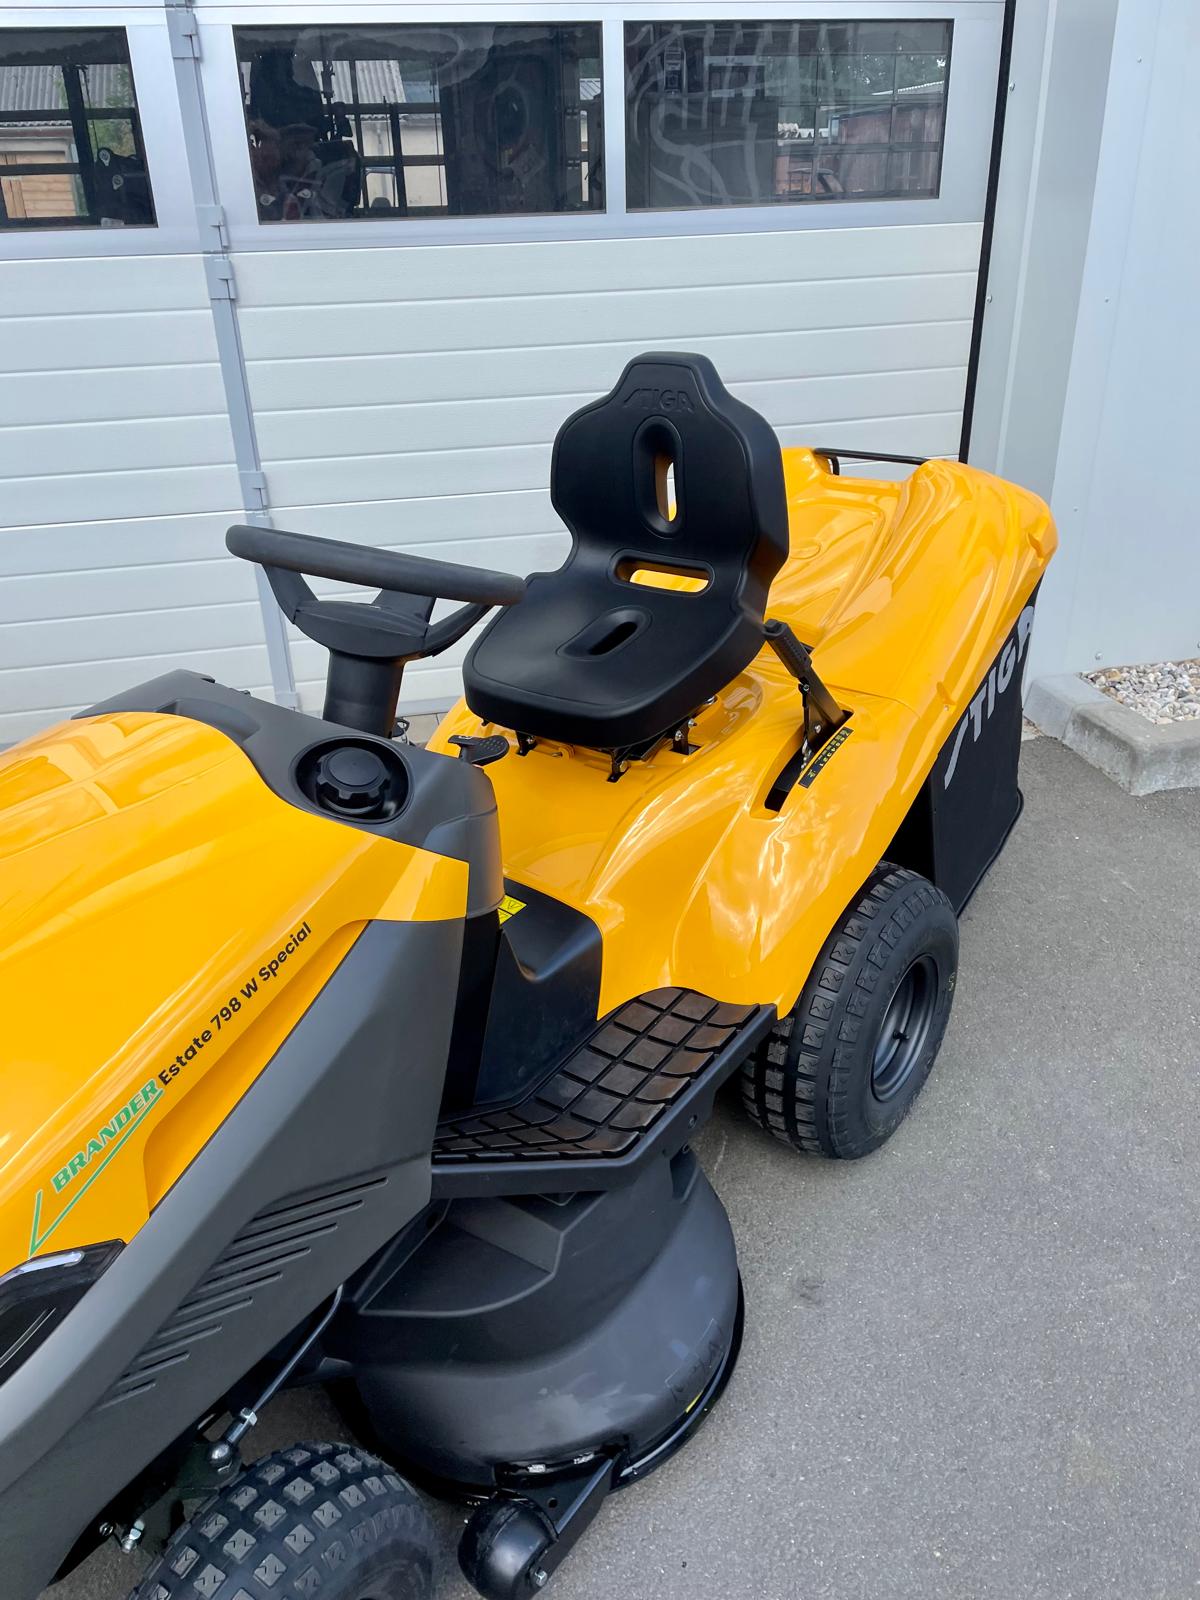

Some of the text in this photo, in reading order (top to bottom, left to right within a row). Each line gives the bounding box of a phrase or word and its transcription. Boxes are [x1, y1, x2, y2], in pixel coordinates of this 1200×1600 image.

[623, 388, 696, 414] STIGA
[944, 606, 1034, 790] STIGA
[51, 921, 312, 1194] BRANDER Estate 798 W Special
